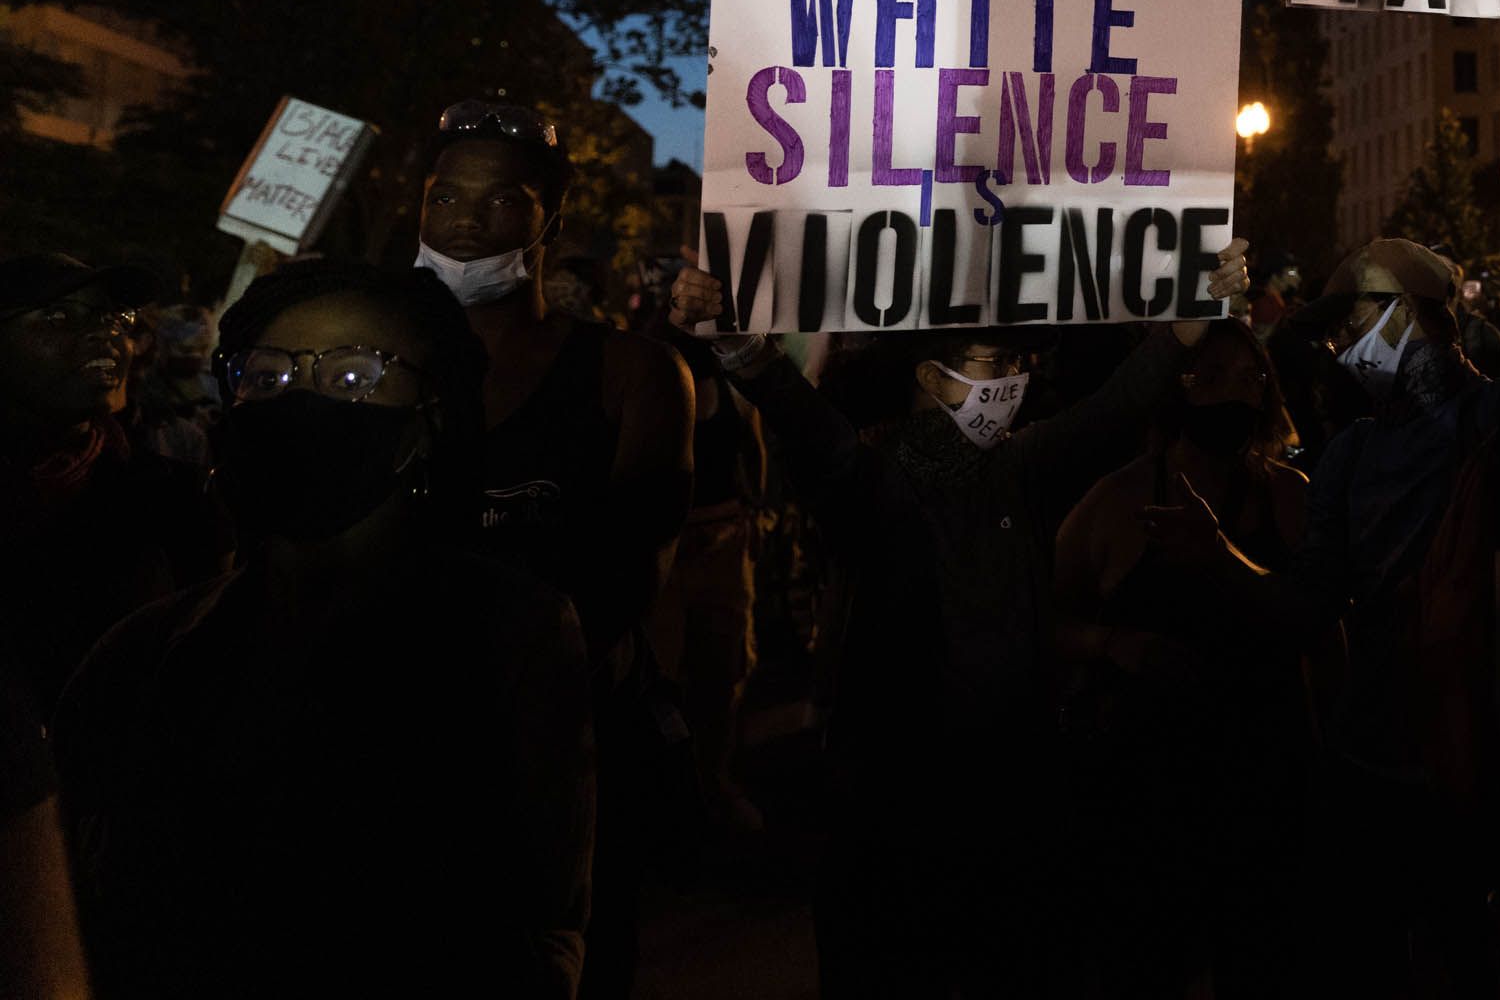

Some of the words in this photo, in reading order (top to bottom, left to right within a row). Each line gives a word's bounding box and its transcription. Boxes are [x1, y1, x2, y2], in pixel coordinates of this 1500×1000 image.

[745, 65, 1178, 188] SILENCE
[919, 169, 1006, 227] IS
[703, 206, 1230, 333] VIOLENCE
